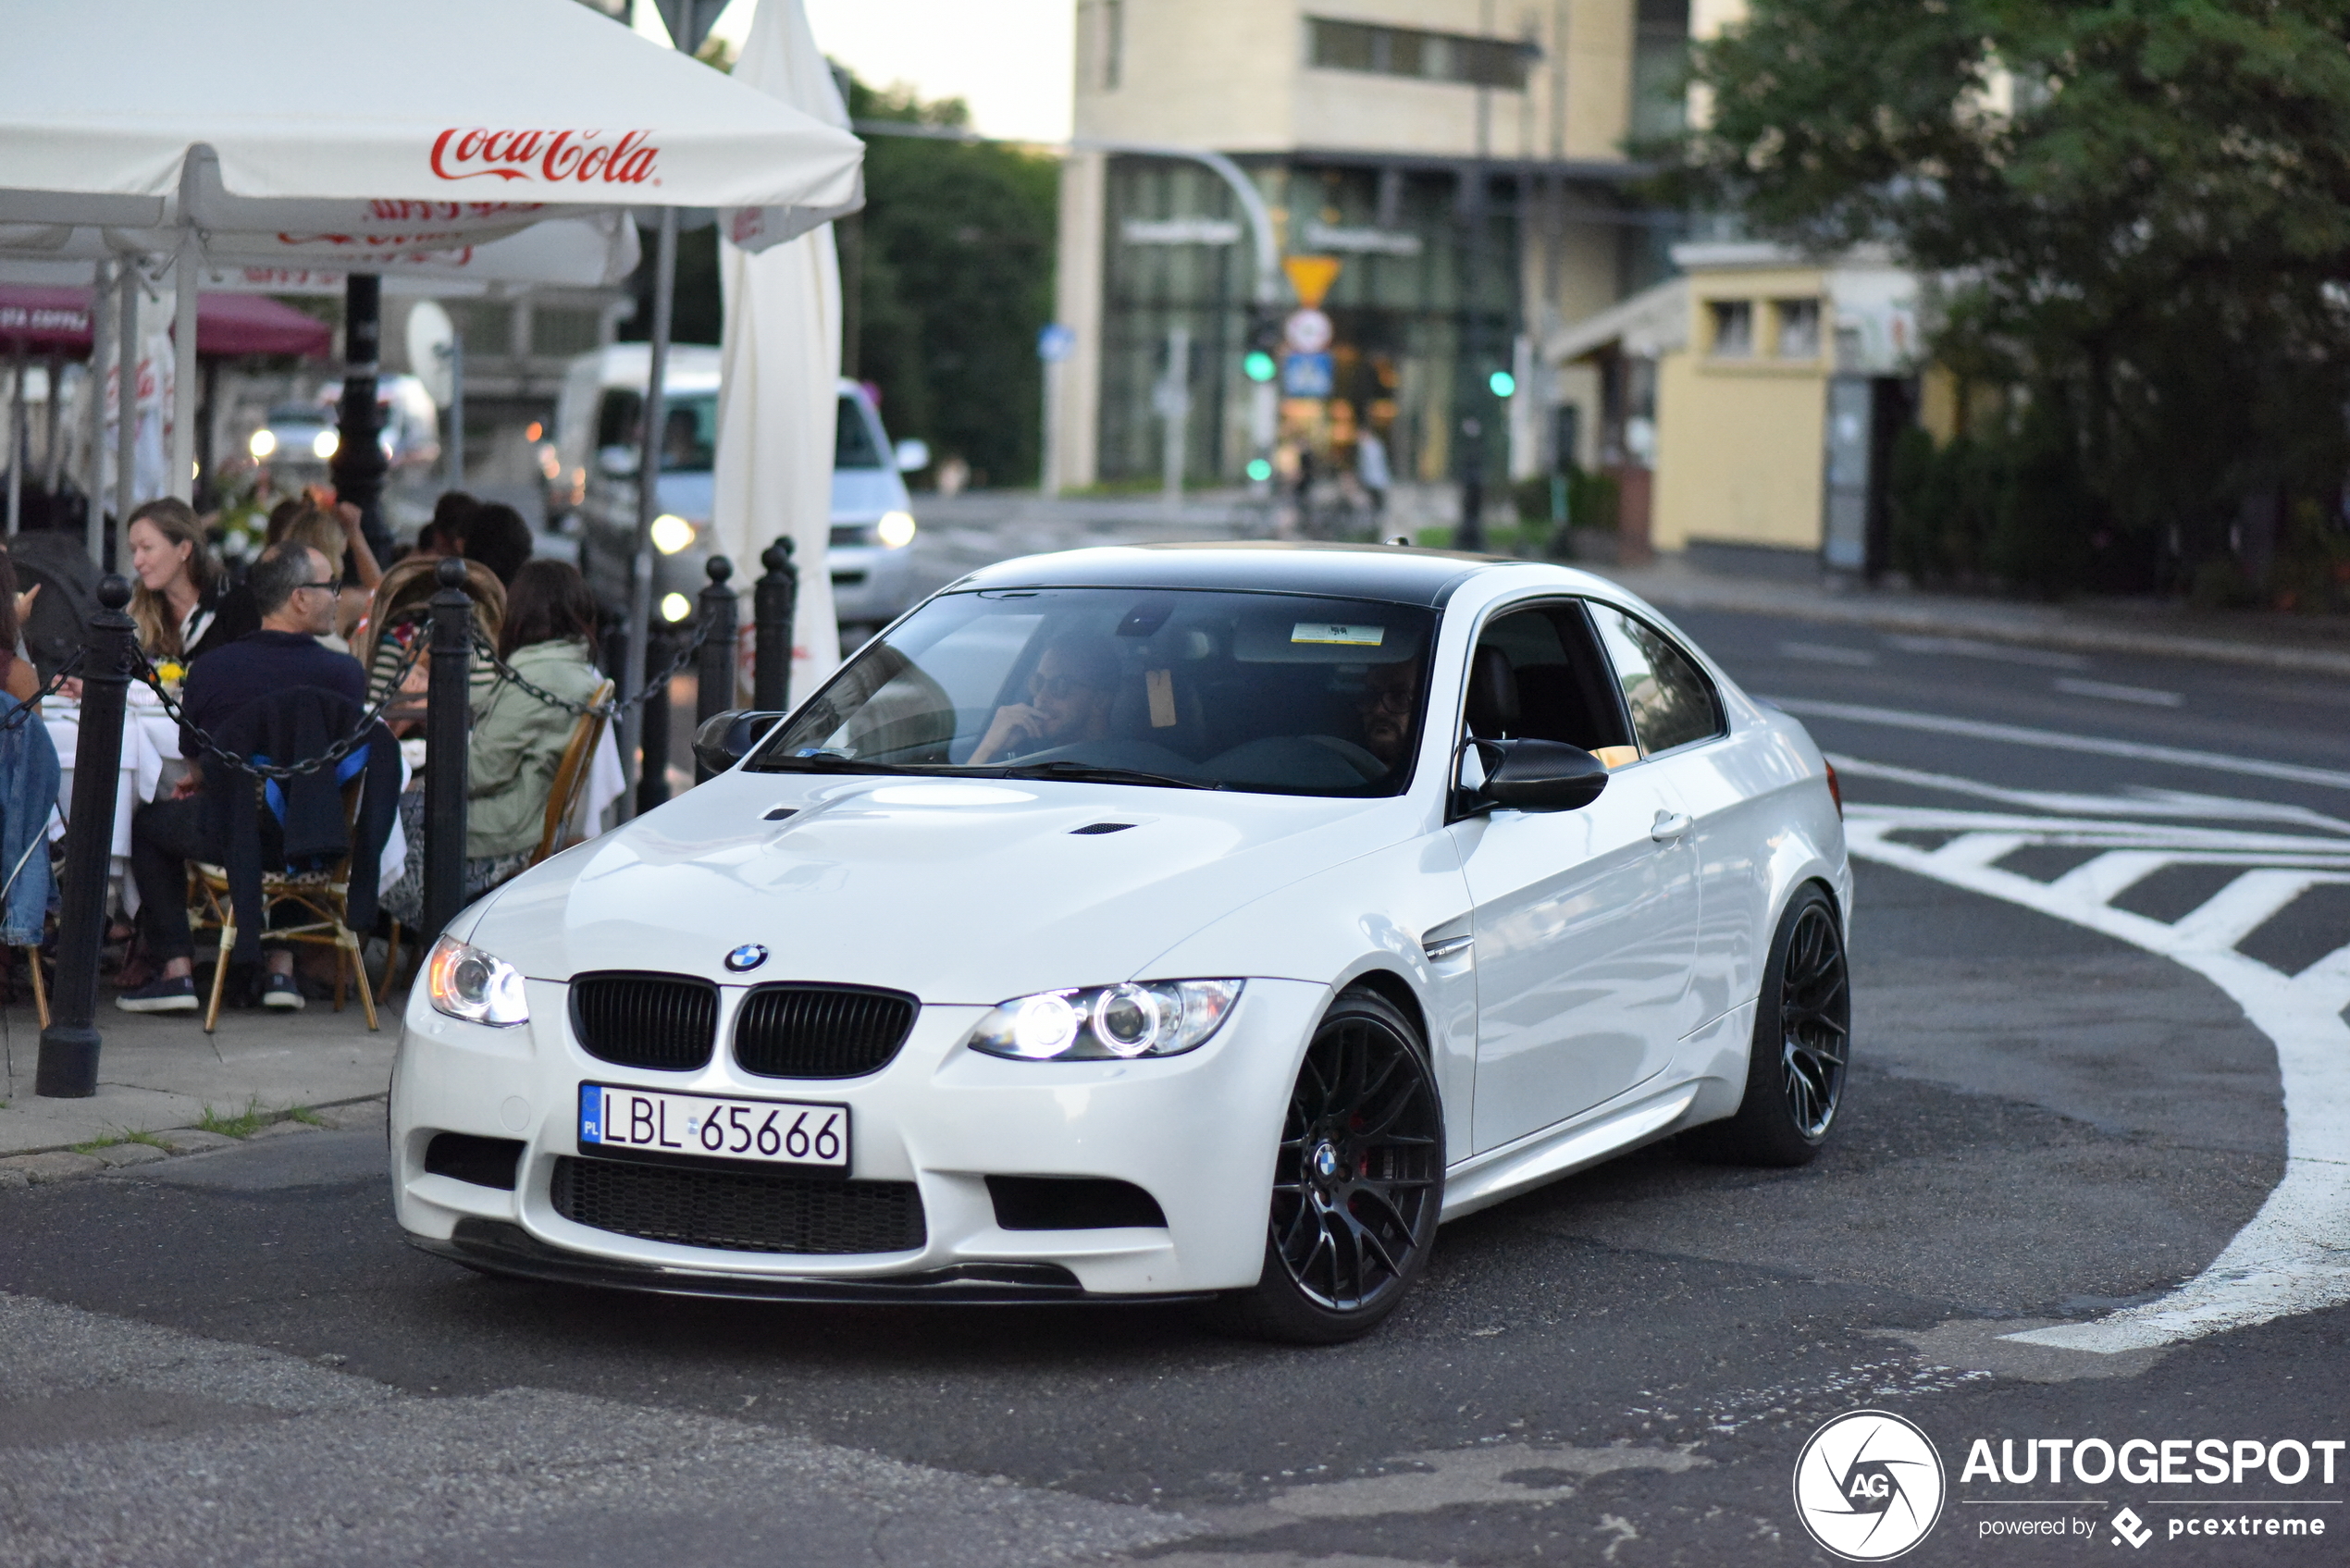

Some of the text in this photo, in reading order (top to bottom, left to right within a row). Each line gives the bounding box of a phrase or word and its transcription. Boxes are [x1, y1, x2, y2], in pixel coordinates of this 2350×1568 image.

[430, 128, 660, 183] Coca-Cola
[584, 1093, 840, 1160] PL LBL 65666
